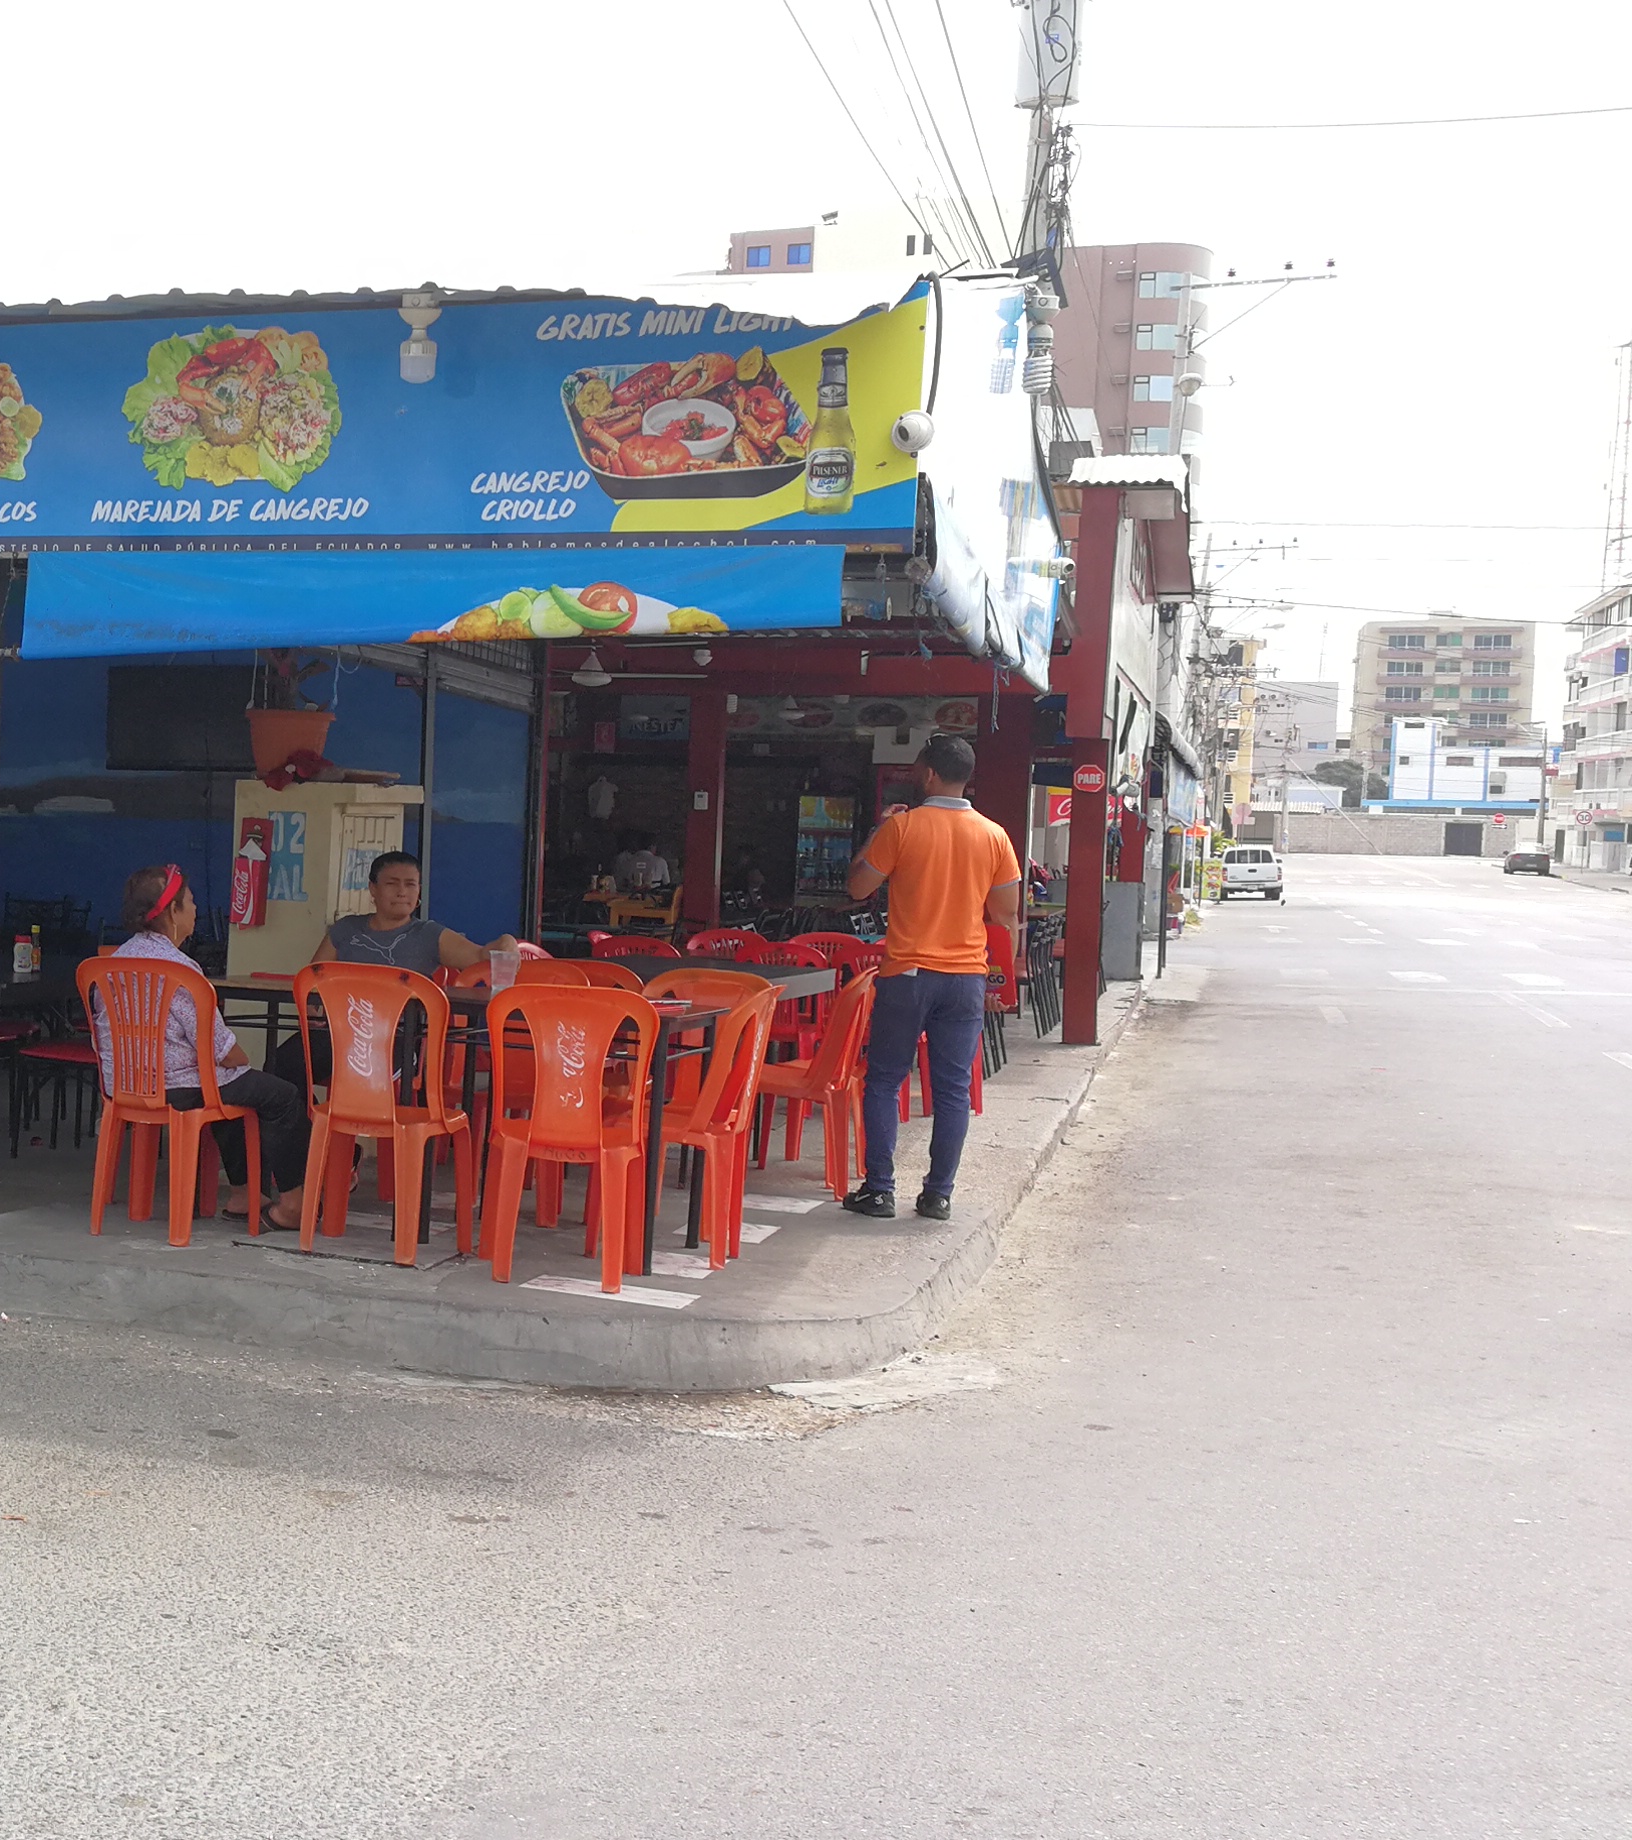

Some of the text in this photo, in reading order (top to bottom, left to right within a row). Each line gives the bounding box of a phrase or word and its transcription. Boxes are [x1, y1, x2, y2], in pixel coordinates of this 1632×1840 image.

[536, 312, 632, 341] GRATIS
[638, 309, 705, 337] MINI
[470, 470, 590, 494] CANGREJO
[812, 465, 848, 476] PILSENER
[91, 497, 369, 523] MAREJADA DE CANGREJO
[481, 498, 577, 521] CRIOLLO
[1077, 773, 1102, 784] PARE
